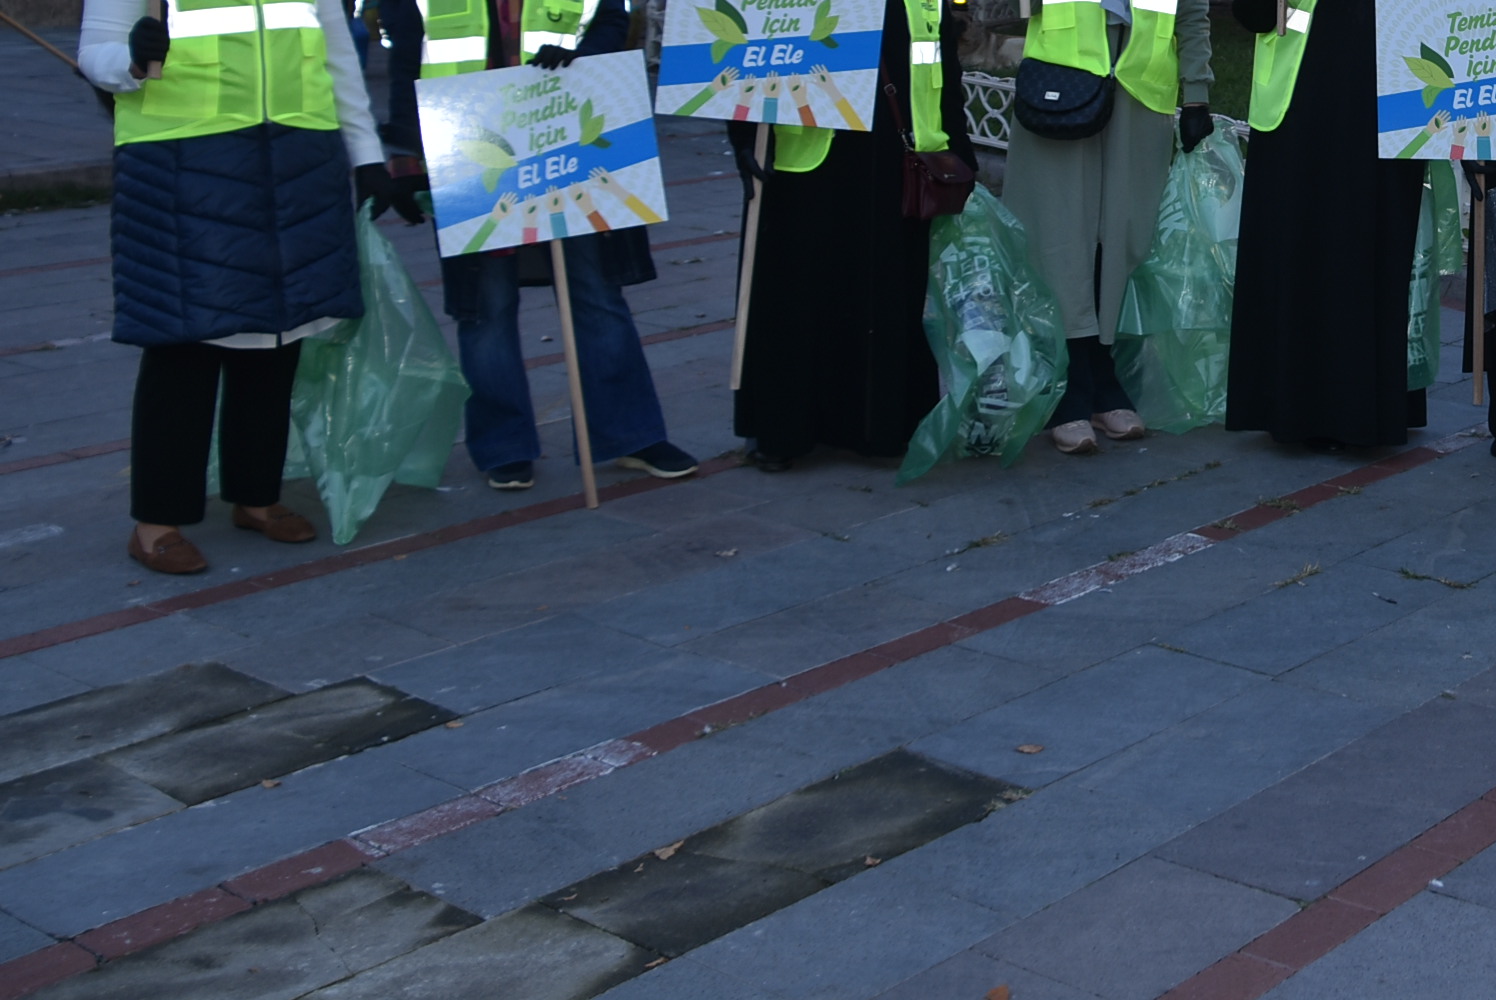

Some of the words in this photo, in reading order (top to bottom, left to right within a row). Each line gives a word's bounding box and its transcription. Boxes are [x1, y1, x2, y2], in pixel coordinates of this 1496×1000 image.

[742, 46, 767, 67] El
[770, 44, 804, 65] Ele
[501, 74, 562, 102] Temiz
[1453, 88, 1474, 110] El
[500, 92, 578, 133] Pendik
[517, 165, 541, 190] El
[544, 154, 579, 180] Ele
